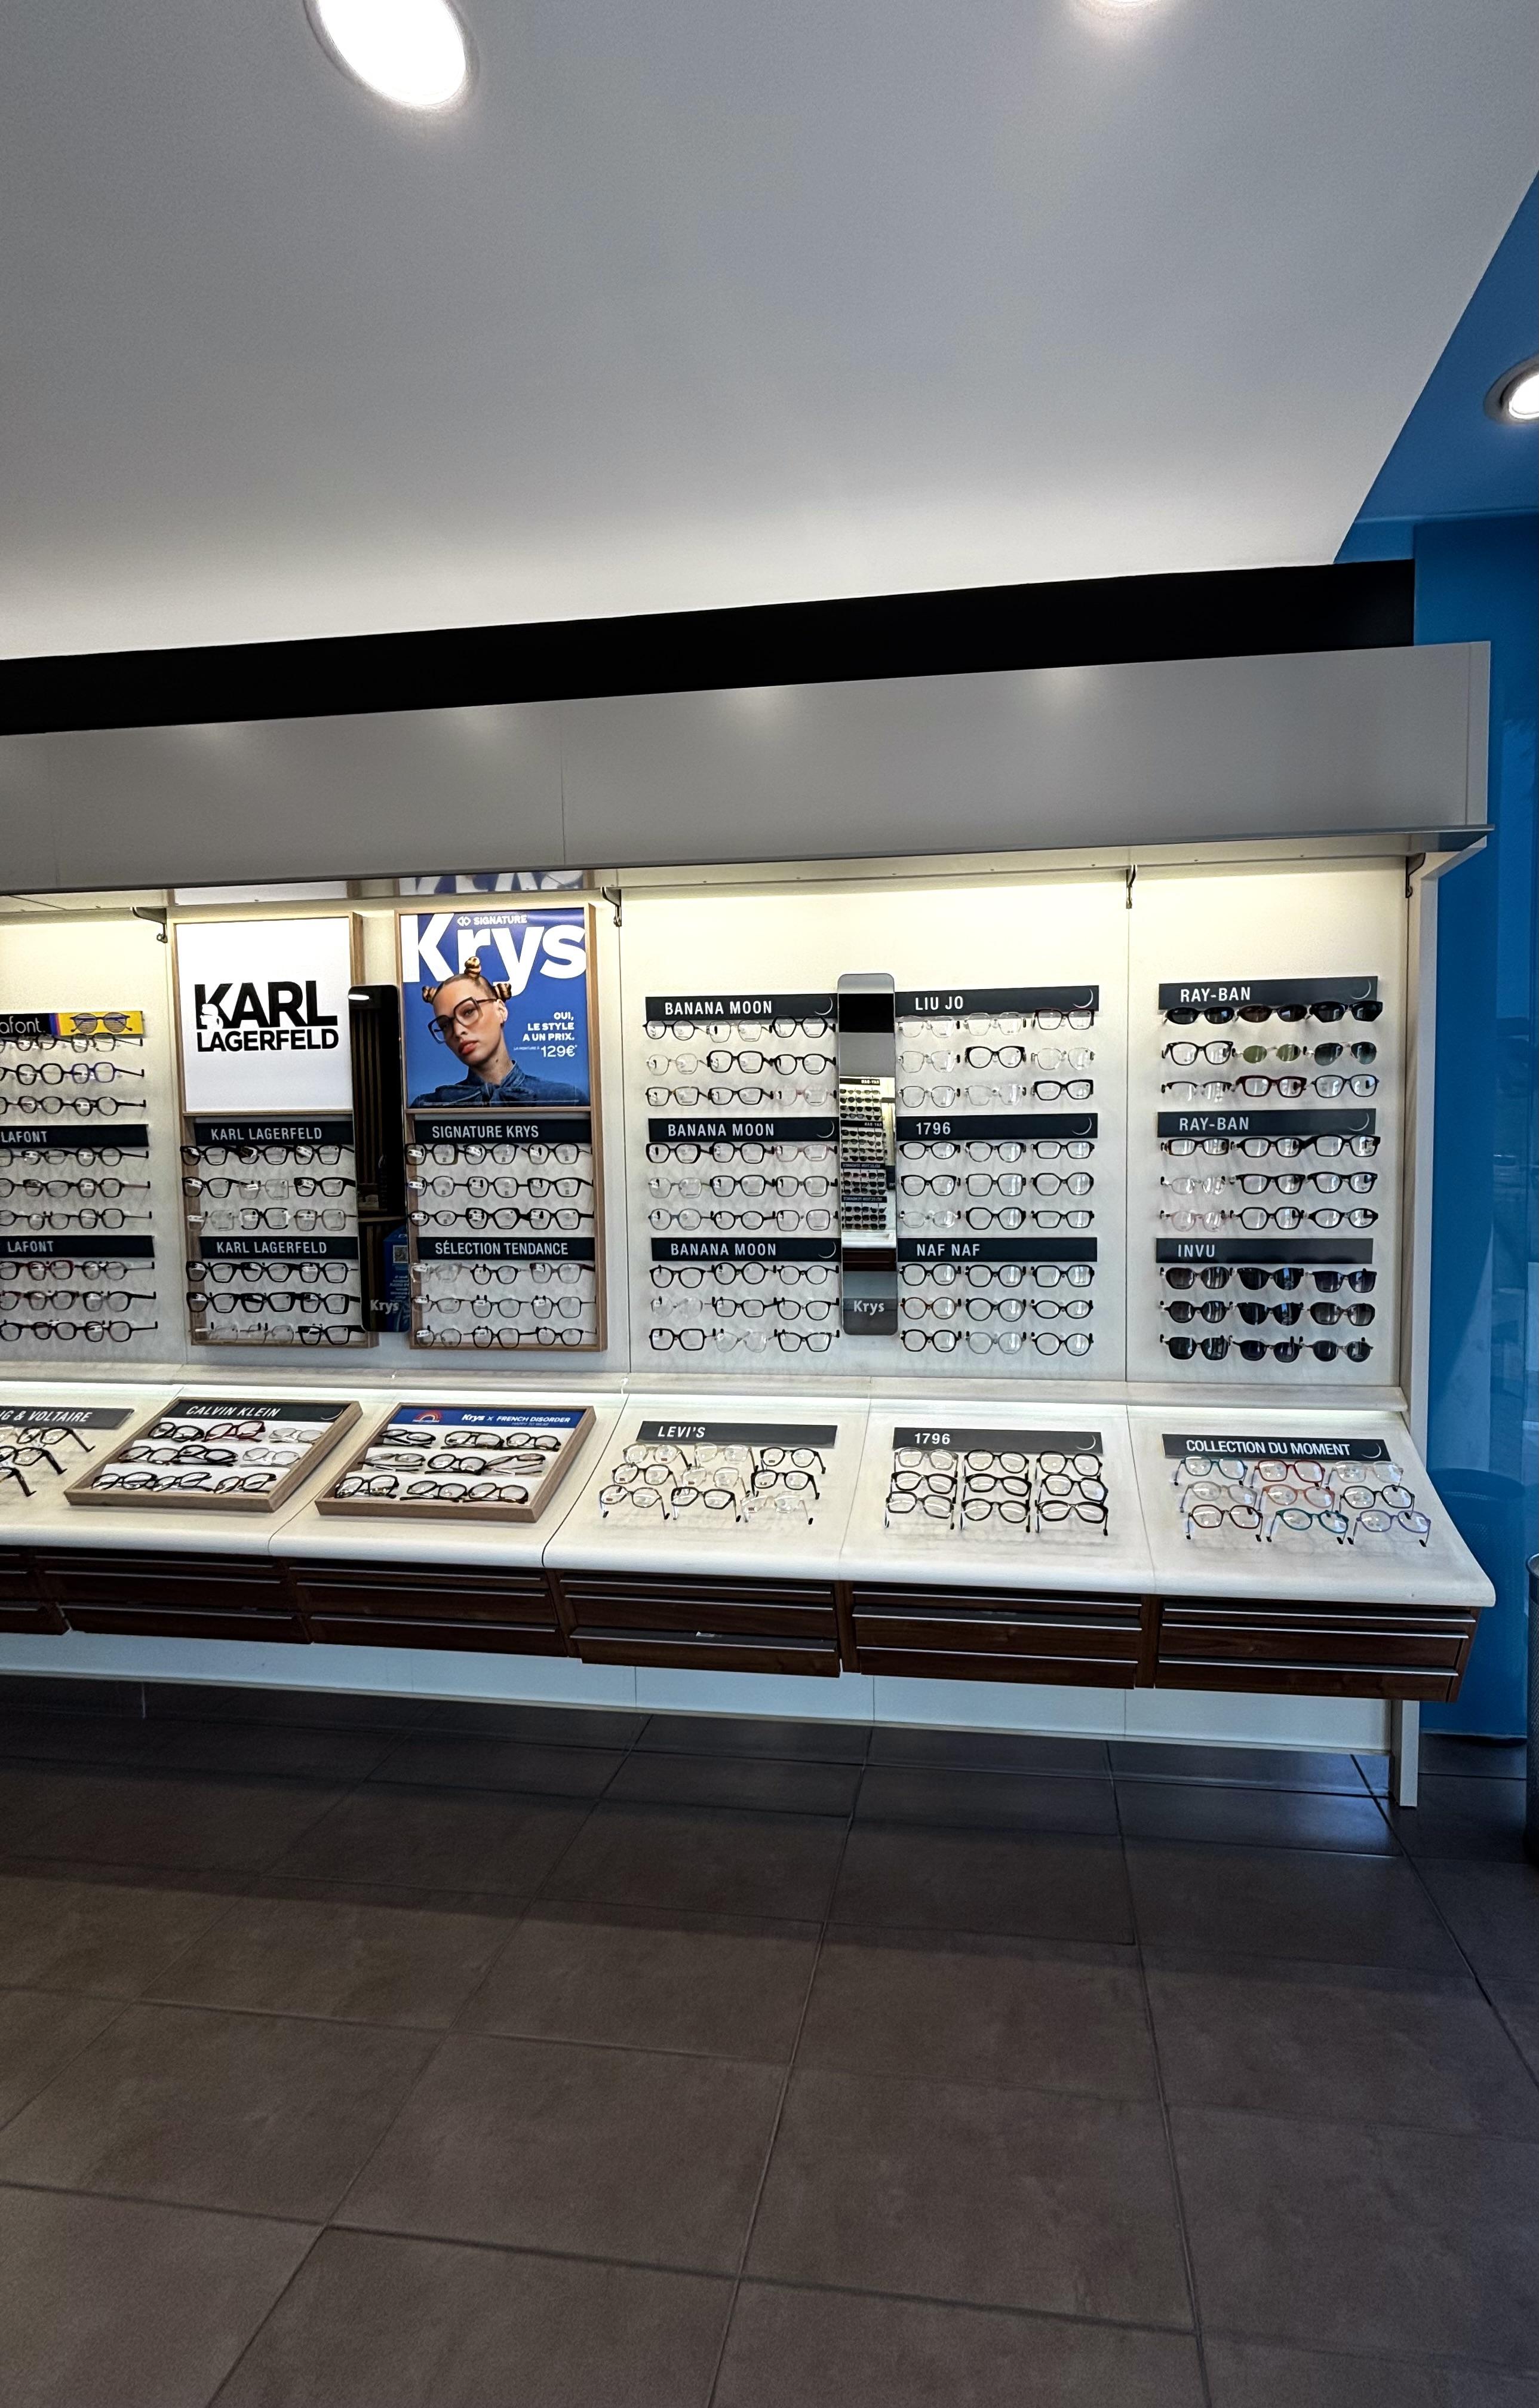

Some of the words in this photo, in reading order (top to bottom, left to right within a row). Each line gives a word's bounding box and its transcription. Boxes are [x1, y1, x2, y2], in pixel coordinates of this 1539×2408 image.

[474, 915, 527, 925] SIGNATURE
[401, 913, 586, 997] Krys
[1180, 987, 1251, 1003] RAY-BAN
[194, 980, 338, 1030] KARL
[665, 1001, 724, 1015] BANANA
[729, 1000, 772, 1015] MOON
[915, 996, 939, 1010] LIU
[945, 996, 963, 1010] JO
[553, 1011, 574, 1021] OUI,
[527, 1023, 540, 1031] LE
[542, 1022, 575, 1031] STYLE
[196, 1028, 339, 1052] LAGERFELD
[668, 1123, 727, 1137] BANANA
[732, 1123, 774, 1137] MOON
[916, 1122, 951, 1135] 1796
[1179, 1117, 1249, 1131] RAY-BAN
[1, 1131, 47, 1143] LAFONT
[211, 1128, 245, 1141] KARL
[248, 1127, 322, 1140] LAGERFELD
[432, 1125, 503, 1138] SIGNATURE
[506, 1125, 539, 1138] KRYS
[7, 1240, 54, 1253] LAFONT
[216, 1242, 250, 1254] KARL
[253, 1241, 327, 1254] LAGERFELD
[435, 1240, 501, 1255] SÉLECTION
[503, 1242, 569, 1255] TENDANCE
[671, 1243, 729, 1256] BANANA
[735, 1243, 776, 1256] MOON
[917, 1243, 945, 1257] NAF
[951, 1243, 980, 1257] NAF
[1178, 1244, 1215, 1258] INVU
[370, 1299, 400, 1314] Krys
[853, 1300, 884, 1316] Krys
[14, 1411, 26, 1421] &
[28, 1411, 93, 1423] VOLTAIRE
[186, 1405, 238, 1416] CALVIN
[236, 1407, 281, 1417] KLEIN
[461, 1414, 486, 1422] Krys
[658, 1426, 706, 1439] LEVI'S
[914, 1433, 950, 1445] 1796
[1185, 1439, 1266, 1454] COLLECTION
[1268, 1442, 1288, 1454] DU
[1289, 1442, 1350, 1455] MOMENT
